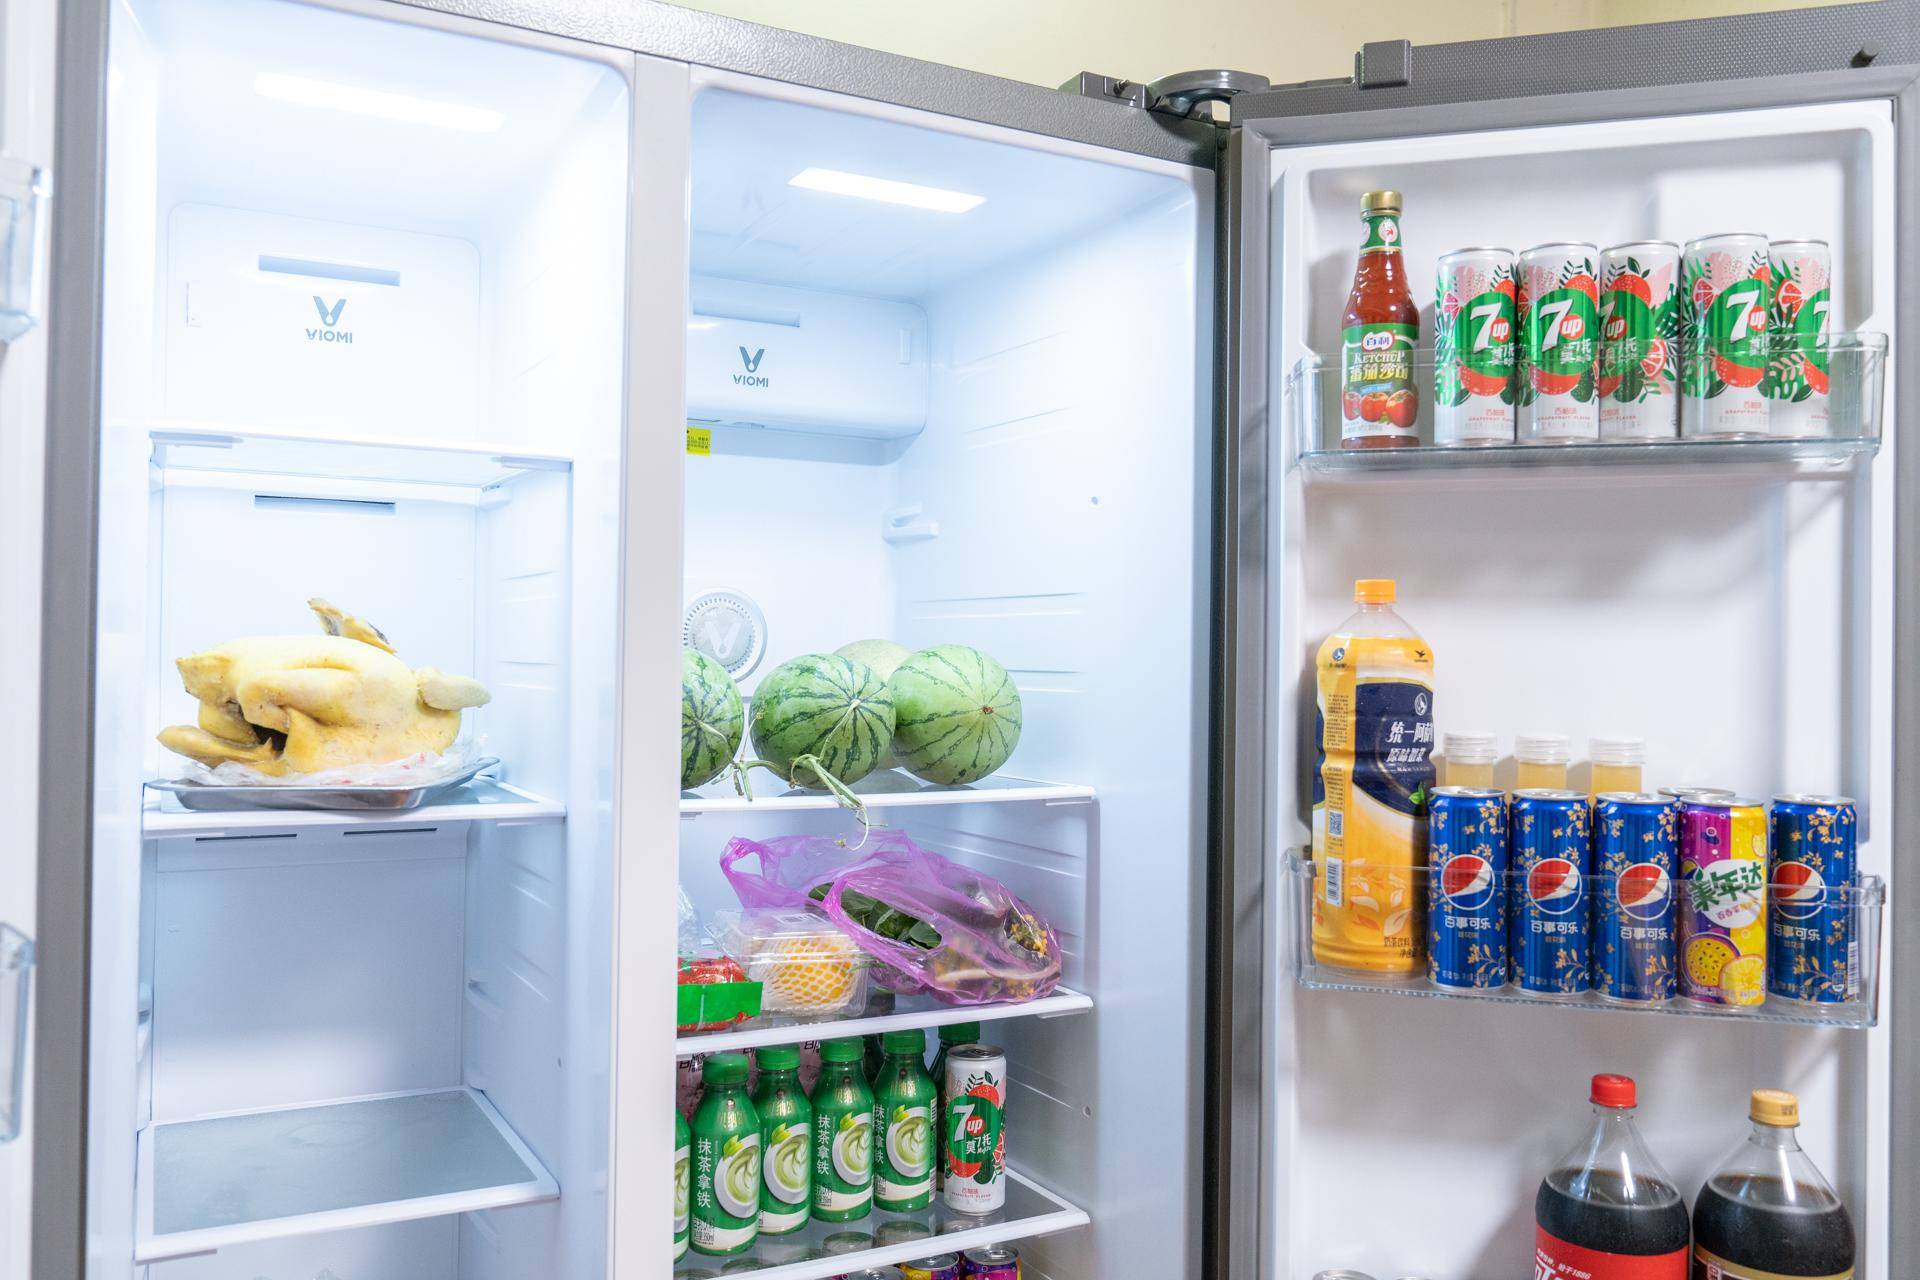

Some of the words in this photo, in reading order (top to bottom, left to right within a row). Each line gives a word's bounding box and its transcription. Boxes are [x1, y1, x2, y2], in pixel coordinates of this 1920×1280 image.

[306, 328, 353, 344] VIOMI
[733, 373, 769, 388] VIOMI
[1687, 861, 1763, 912] 美年达
[1444, 915, 1491, 929] 百事可乐
[1530, 919, 1578, 934] 百事可乐
[1620, 926, 1668, 941] 百事可乐
[1773, 923, 1821, 941] 百事可乐
[816, 1113, 831, 1175] 抹茶拿铁
[696, 1137, 711, 1208] 抹茶拿铁
